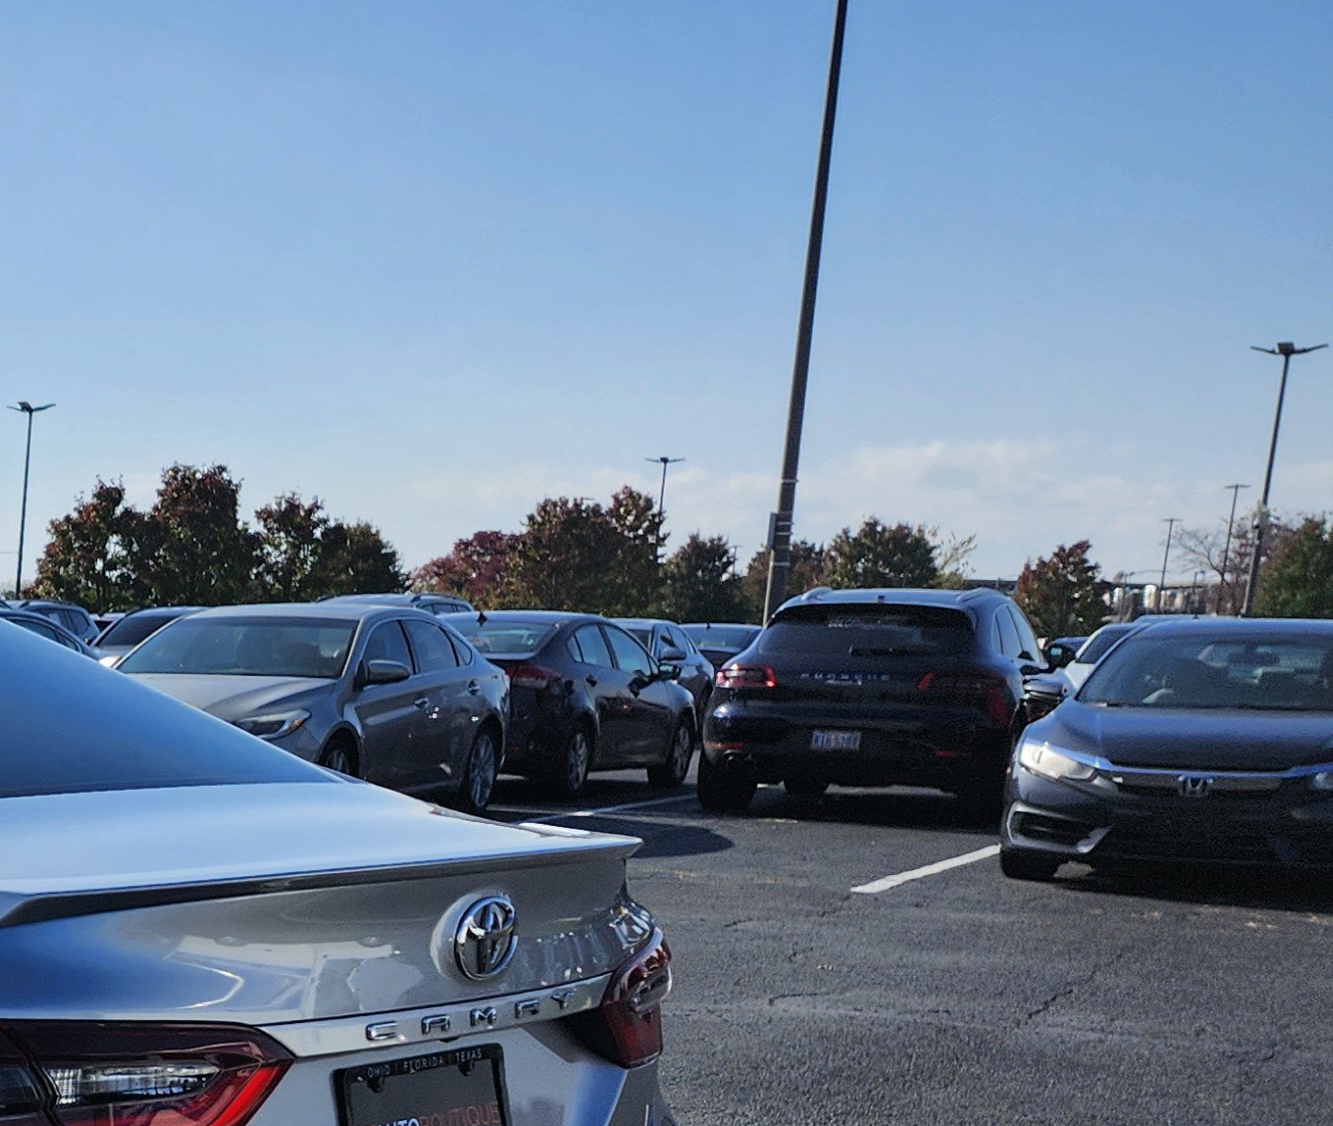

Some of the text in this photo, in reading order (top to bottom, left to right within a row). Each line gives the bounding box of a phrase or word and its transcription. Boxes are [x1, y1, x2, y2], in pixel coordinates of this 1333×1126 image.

[366, 991, 576, 1041] CAMRY
[367, 1048, 483, 1079] OHIO FLORIDA TEXAS
